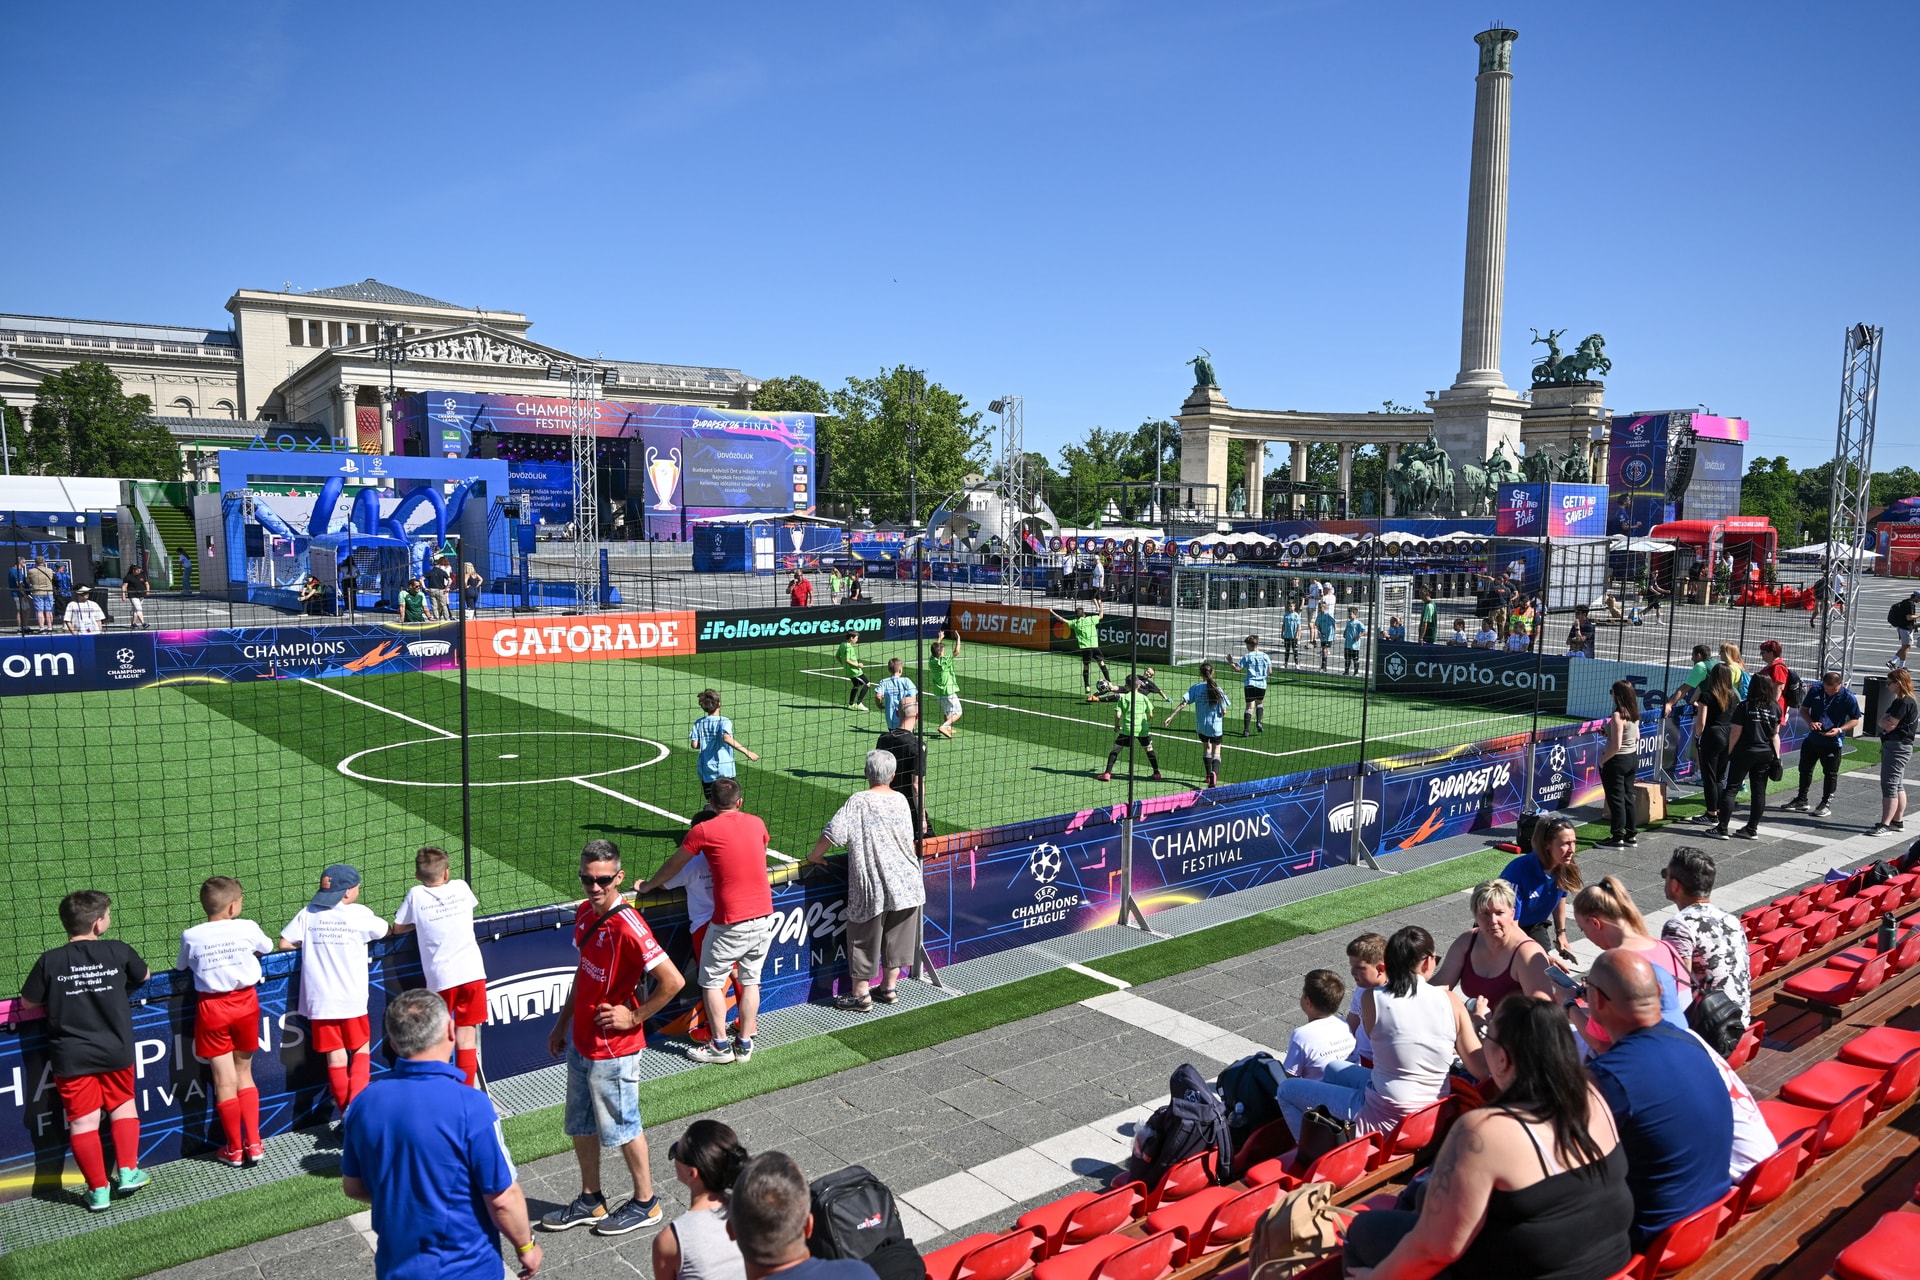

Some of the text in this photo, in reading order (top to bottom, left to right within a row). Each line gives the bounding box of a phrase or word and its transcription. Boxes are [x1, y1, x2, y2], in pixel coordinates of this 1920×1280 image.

[743, 422, 776, 432] FINAL
[1512, 489, 1530, 500] GET
[1562, 495, 1578, 509] GET
[701, 616, 882, 640] FollowScores.com
[976, 613, 1037, 636] JUST EAT
[492, 621, 678, 657] GATORADE
[1098, 626, 1168, 649] stercard
[243, 641, 346, 659] CHAMPIONS
[107, 668, 146, 676] CHAMPIONS
[269, 657, 323, 668] FESTIVAL
[1415, 659, 1556, 692] crypto.com
[1428, 767, 1491, 806] BUDAPEST
[1538, 781, 1572, 795] CHAMPIONS
[1543, 790, 1565, 802] LEAGUE
[1449, 796, 1491, 818] FINAL
[1151, 814, 1271, 860] CHAMPIONS
[1181, 847, 1243, 875] FESTIVAL
[1035, 887, 1056, 900] UEFA
[1011, 895, 1078, 919] CHAMPIONS
[1023, 910, 1066, 928] LEAGUE
[70, 962, 103, 973] Tanévzáró
[774, 944, 847, 975] FINA
